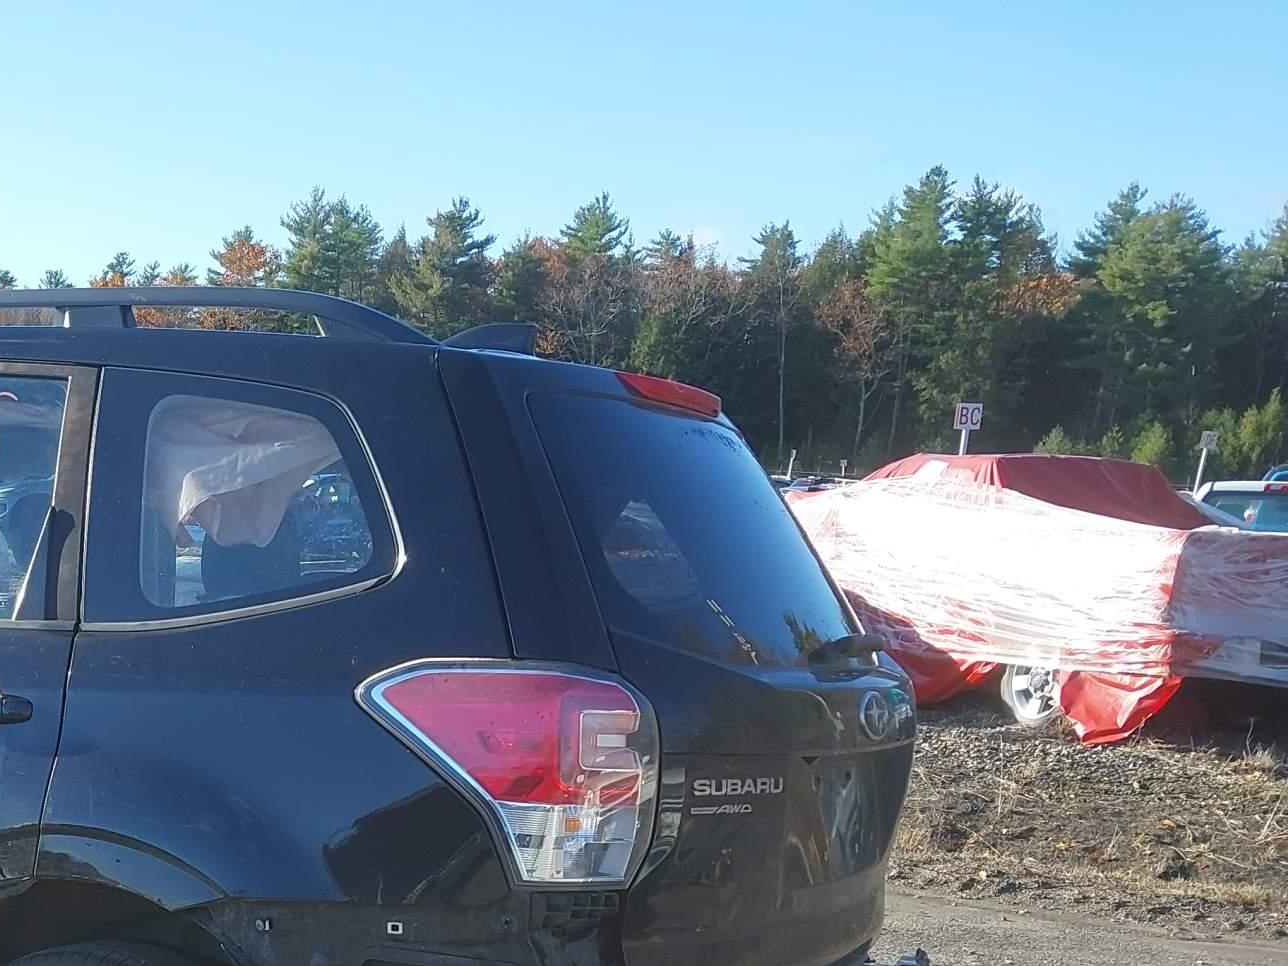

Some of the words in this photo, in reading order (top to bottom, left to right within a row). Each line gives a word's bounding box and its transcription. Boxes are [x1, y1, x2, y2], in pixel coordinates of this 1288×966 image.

[959, 407, 981, 425] BC
[693, 777, 784, 797] SUBARU
[714, 803, 753, 814] AWD
